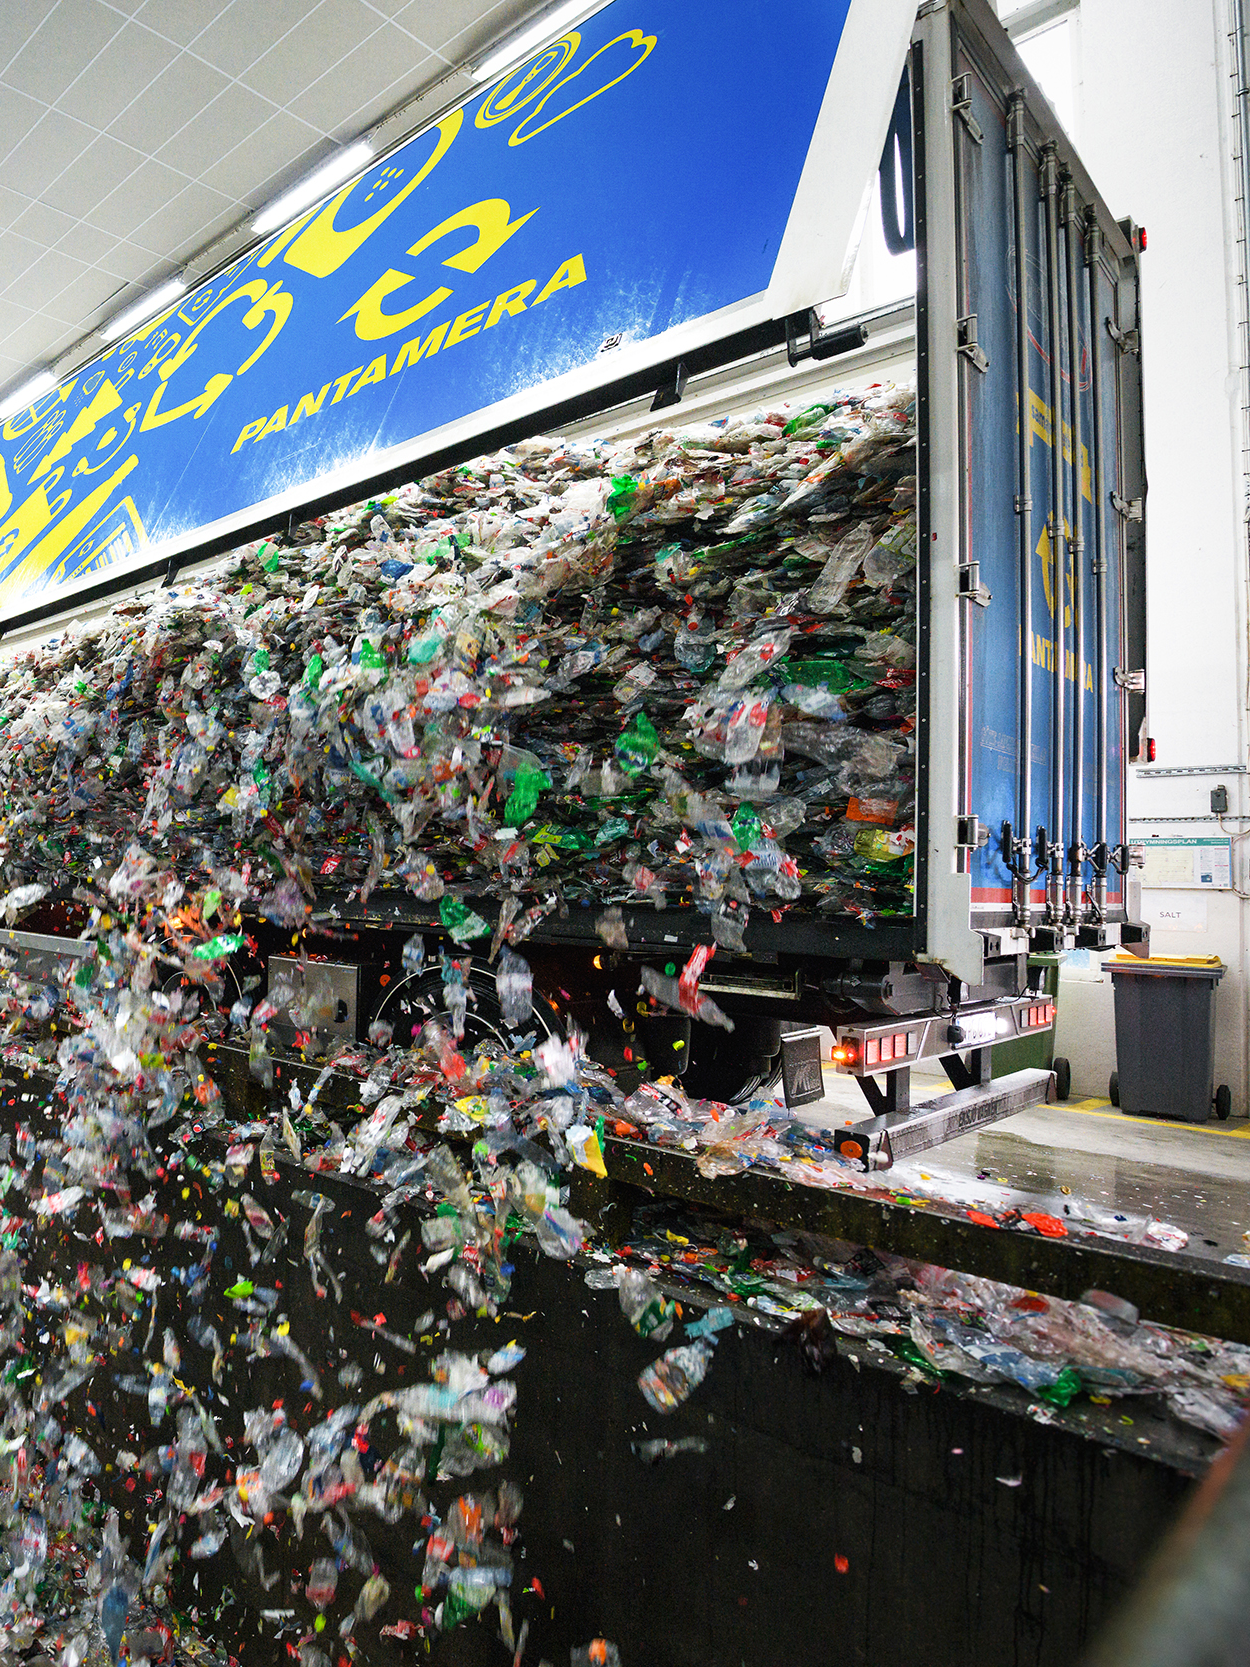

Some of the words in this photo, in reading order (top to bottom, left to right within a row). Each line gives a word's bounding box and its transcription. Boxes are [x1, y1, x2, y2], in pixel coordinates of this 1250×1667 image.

[230, 253, 588, 455] PANTAMERA
[1019, 624, 1094, 693] ANTMRA
[1159, 911, 1182, 919] SALT
